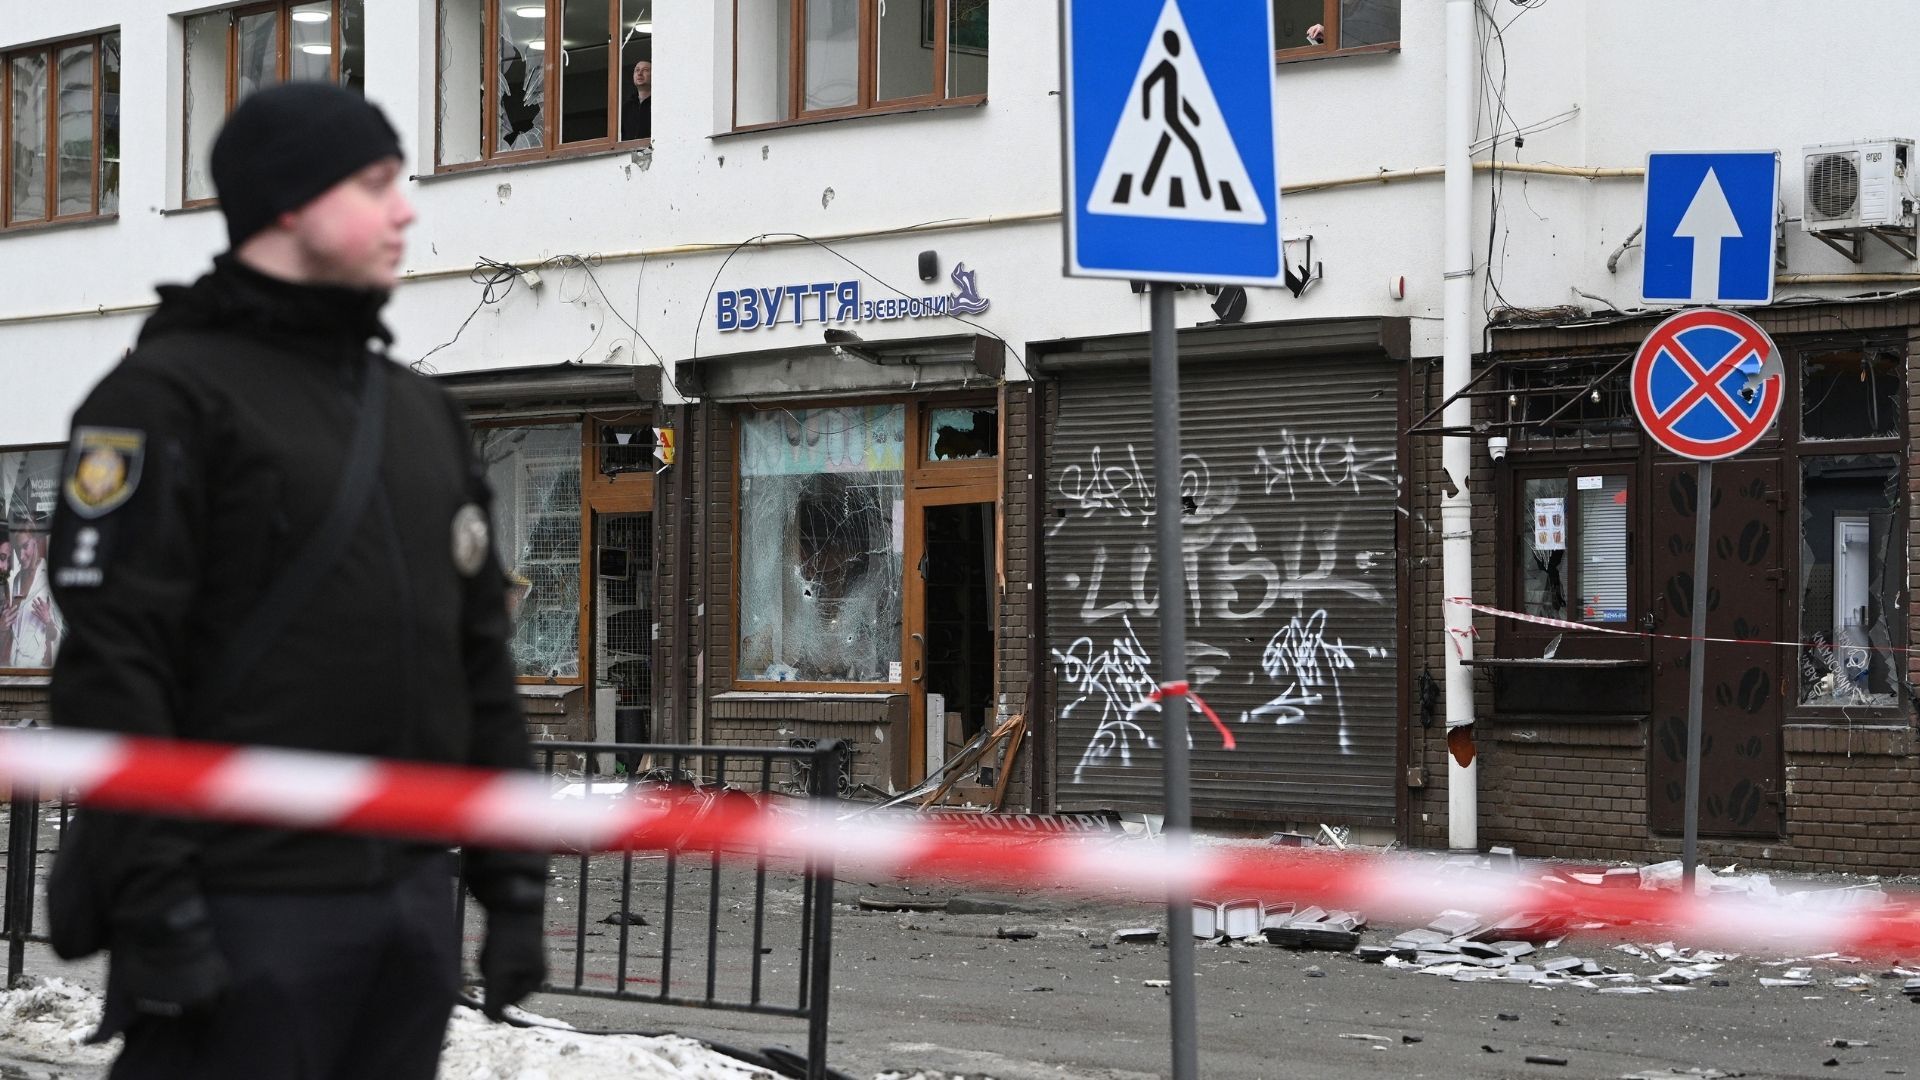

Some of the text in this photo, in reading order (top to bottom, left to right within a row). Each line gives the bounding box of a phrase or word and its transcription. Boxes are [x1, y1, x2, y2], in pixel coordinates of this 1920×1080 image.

[1865, 152, 1882, 163] ergo
[717, 279, 860, 332] ВЗУТТЯ
[1044, 814, 1111, 834] ПАРУ
